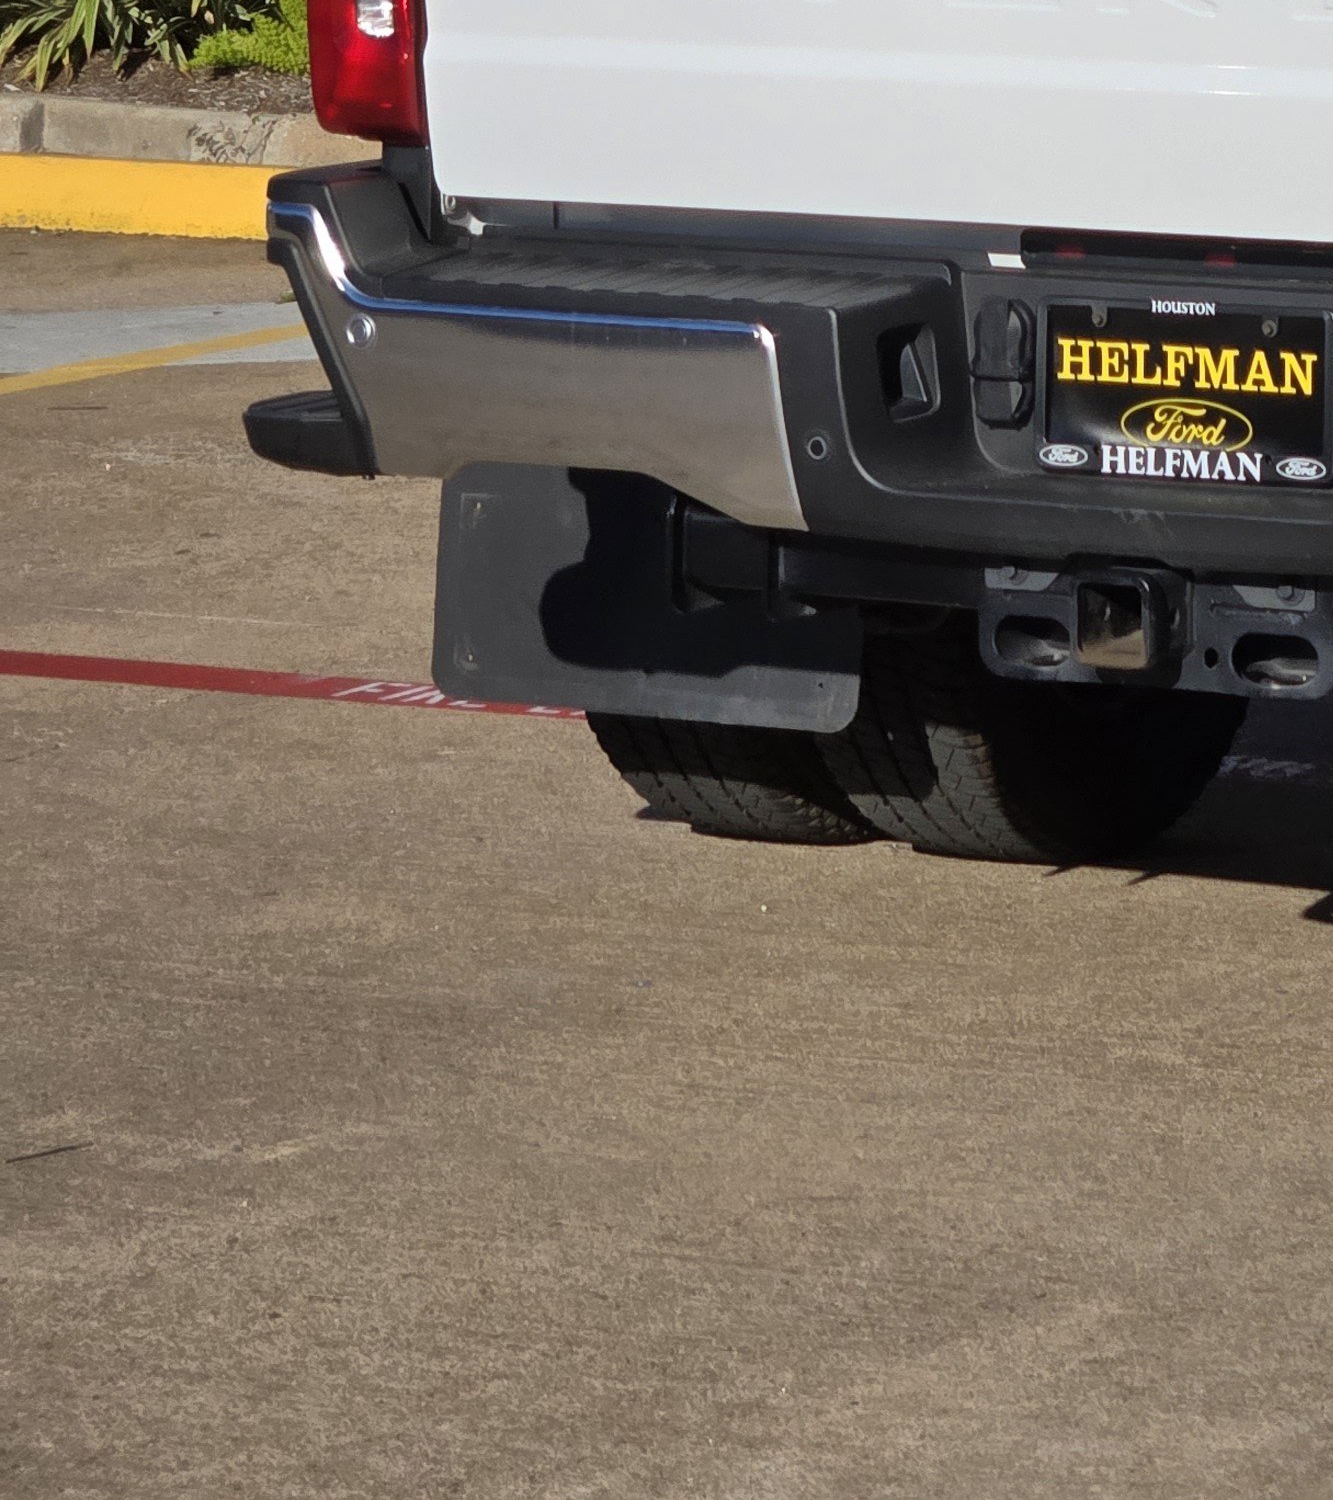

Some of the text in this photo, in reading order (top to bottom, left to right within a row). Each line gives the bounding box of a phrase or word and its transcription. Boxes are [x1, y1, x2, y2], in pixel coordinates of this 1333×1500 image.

[1151, 299, 1216, 316] HOUSTON
[1057, 336, 1317, 396] HELFMAN
[1146, 404, 1227, 446] Ford
[1048, 444, 1318, 483] Ford HELFMAN Ford
